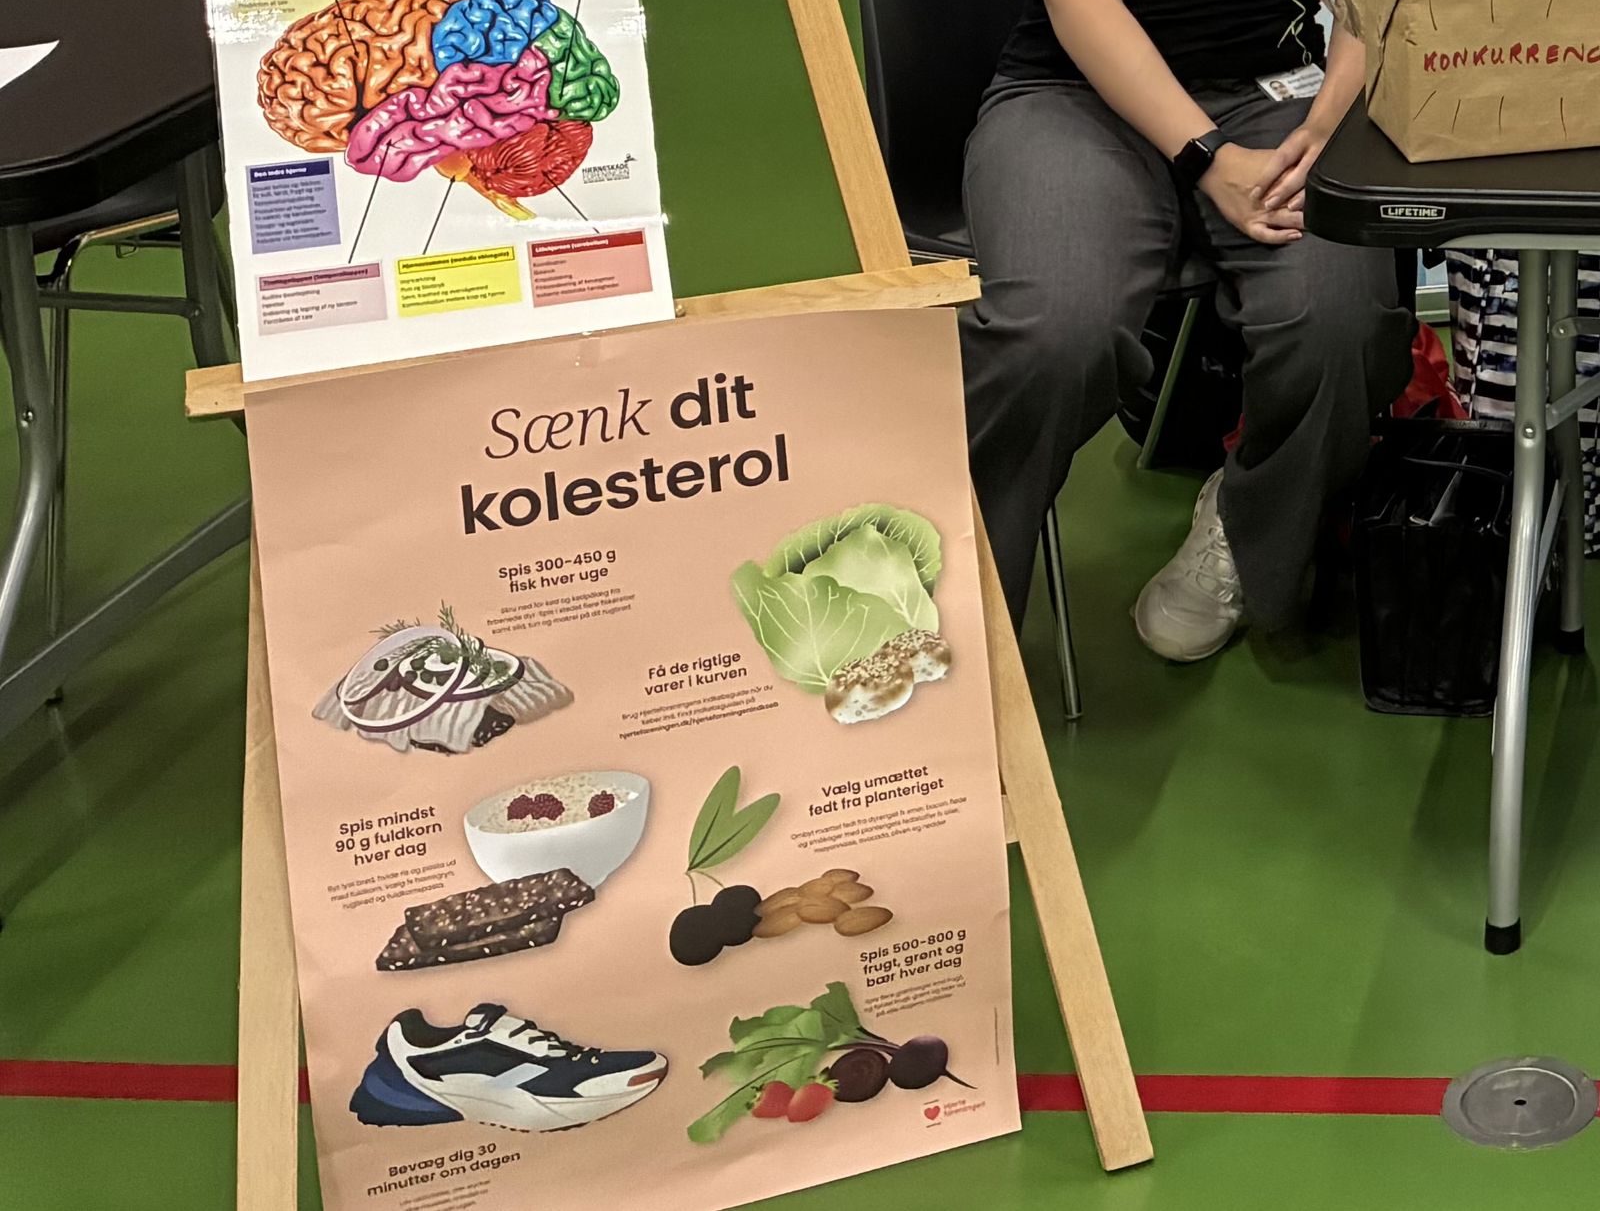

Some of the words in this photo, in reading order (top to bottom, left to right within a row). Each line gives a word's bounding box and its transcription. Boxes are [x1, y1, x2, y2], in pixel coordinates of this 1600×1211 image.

[1388, 207, 1438, 217] LIFETIME
[484, 388, 653, 459] Sænk
[670, 372, 757, 429] dit
[460, 433, 789, 535] kolesterol
[498, 563, 531, 580] Spis
[535, 550, 602, 572] 300-450
[606, 549, 616, 563] g
[510, 580, 537, 593] fisk
[540, 572, 575, 588] hver
[579, 567, 609, 582] uge
[644, 679, 685, 696] varer
[688, 675, 692, 687] i
[696, 667, 747, 686] kurven
[648, 664, 666, 680] Få
[670, 662, 689, 675] de
[692, 652, 741, 671] rigtige
[821, 780, 861, 797] Vælg
[864, 766, 929, 789] umættet
[808, 801, 838, 817] fedt
[840, 796, 861, 810] fra
[865, 778, 945, 807] planteriget
[335, 838, 355, 852] 90
[359, 837, 370, 851] g
[374, 822, 442, 844] fuldkorn
[339, 819, 373, 837] Spis
[378, 806, 436, 828] mindst
[354, 849, 390, 866] hver
[394, 842, 427, 857] dag
[859, 947, 889, 963] Spis
[893, 930, 954, 954] 500-800
[957, 929, 966, 941] g
[863, 958, 901, 975] frugt,
[904, 948, 943, 966] grønt
[946, 943, 964, 954] og
[866, 972, 896, 987] bær
[899, 964, 931, 979] hver
[934, 957, 962, 970] dag
[367, 1172, 436, 1197] minutter
[439, 1164, 466, 1179] om
[470, 1152, 521, 1172] dagen
[388, 1156, 445, 1177] Bevæg
[449, 1149, 474, 1163] dig
[478, 1142, 497, 1156] 30
